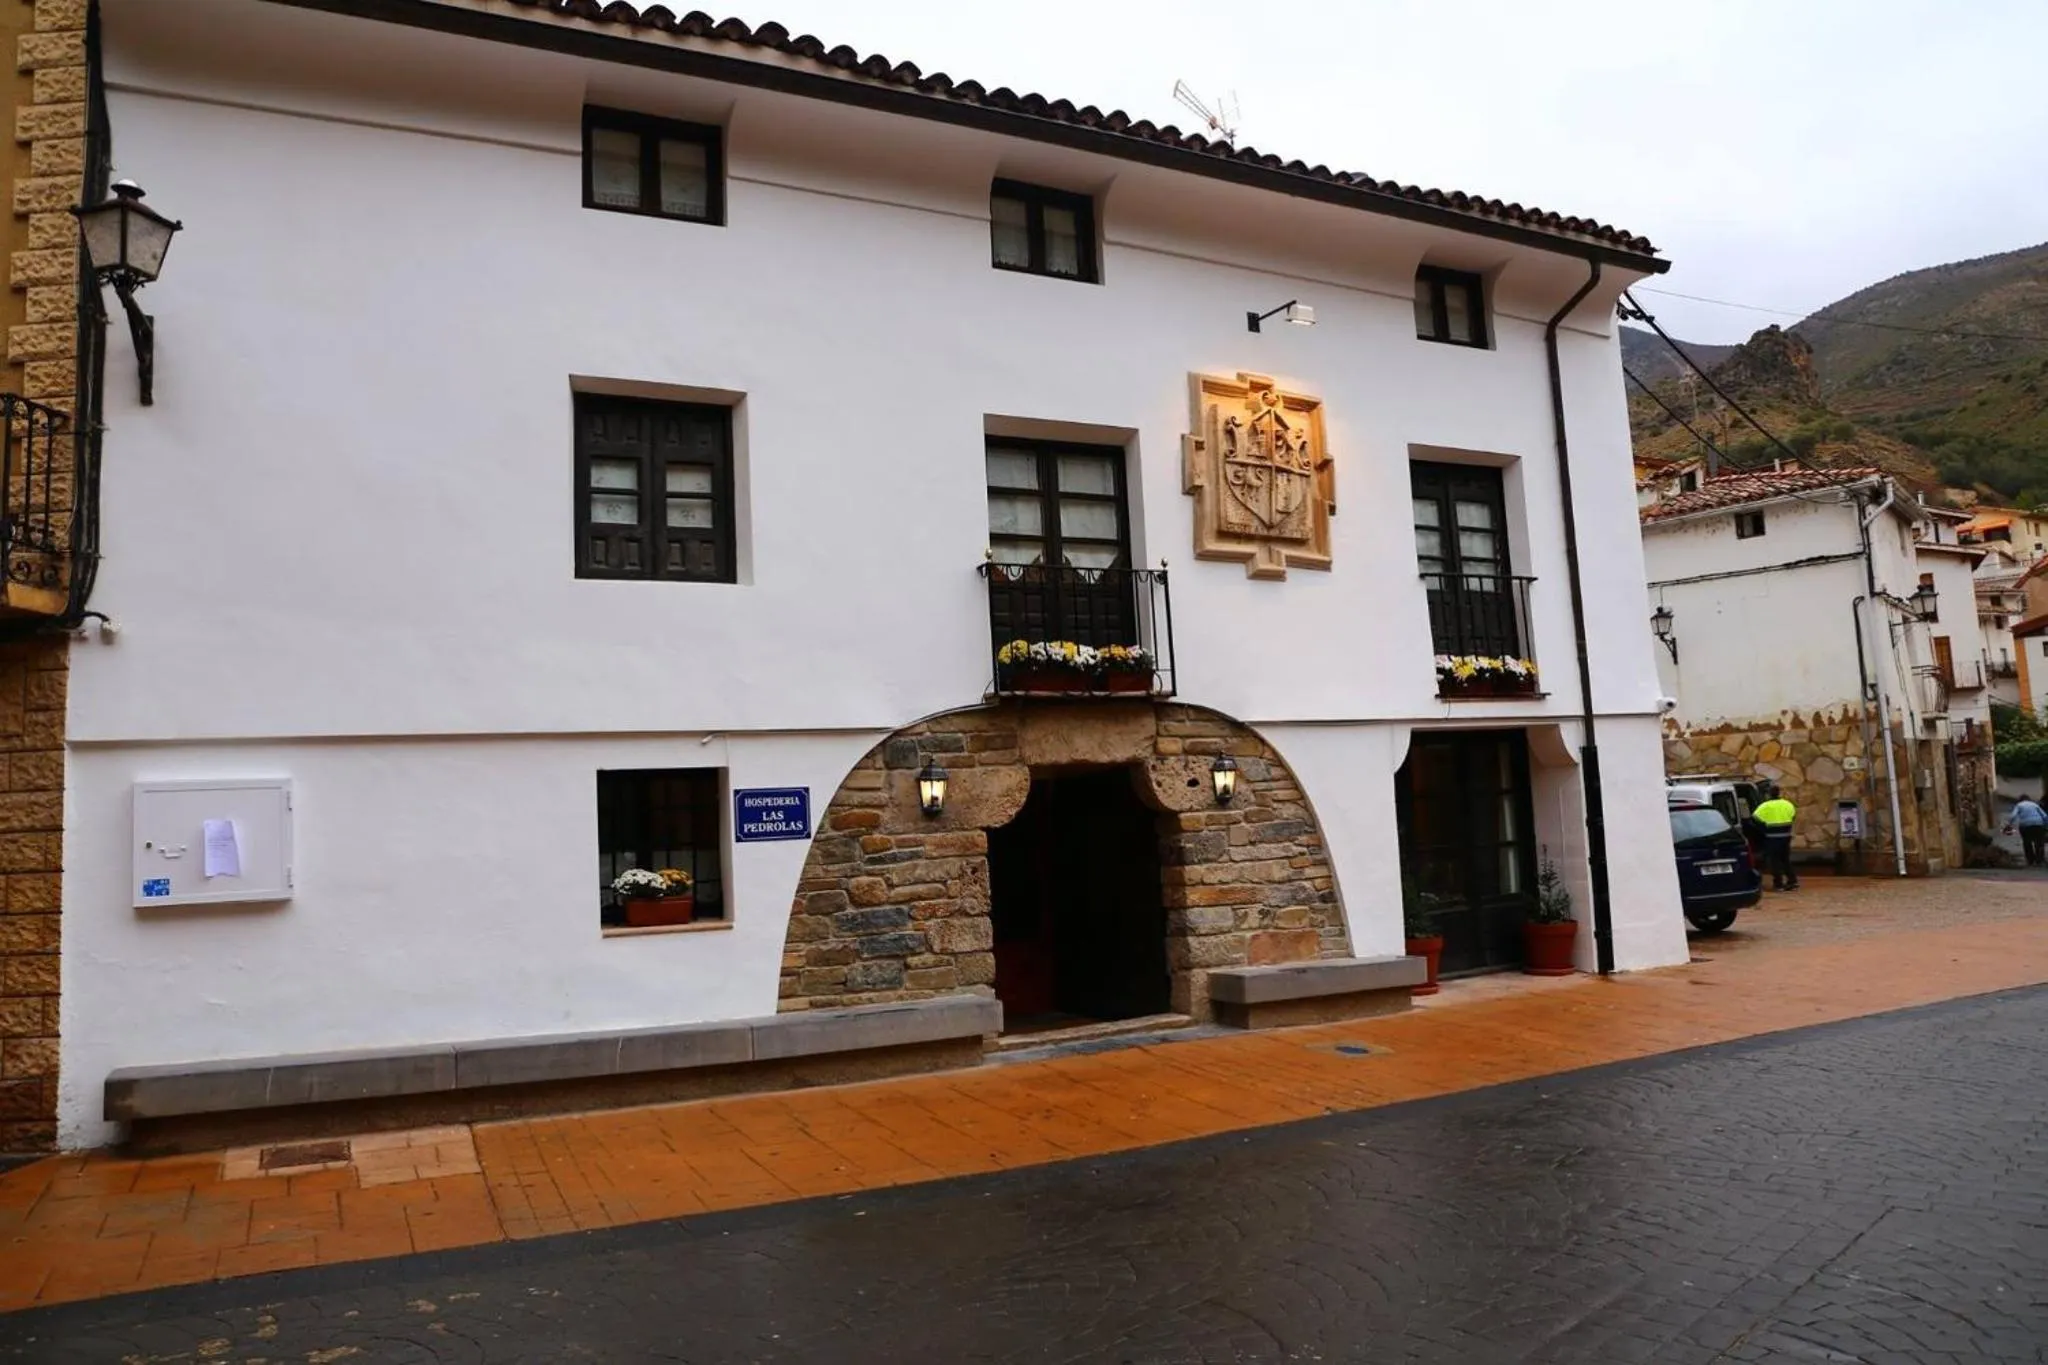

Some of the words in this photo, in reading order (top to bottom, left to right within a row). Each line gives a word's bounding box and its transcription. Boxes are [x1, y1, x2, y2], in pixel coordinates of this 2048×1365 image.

[744, 797, 801, 807] HOSPEDERIA
[762, 810, 784, 821] LAS
[743, 820, 804, 833] PEDROLAS
